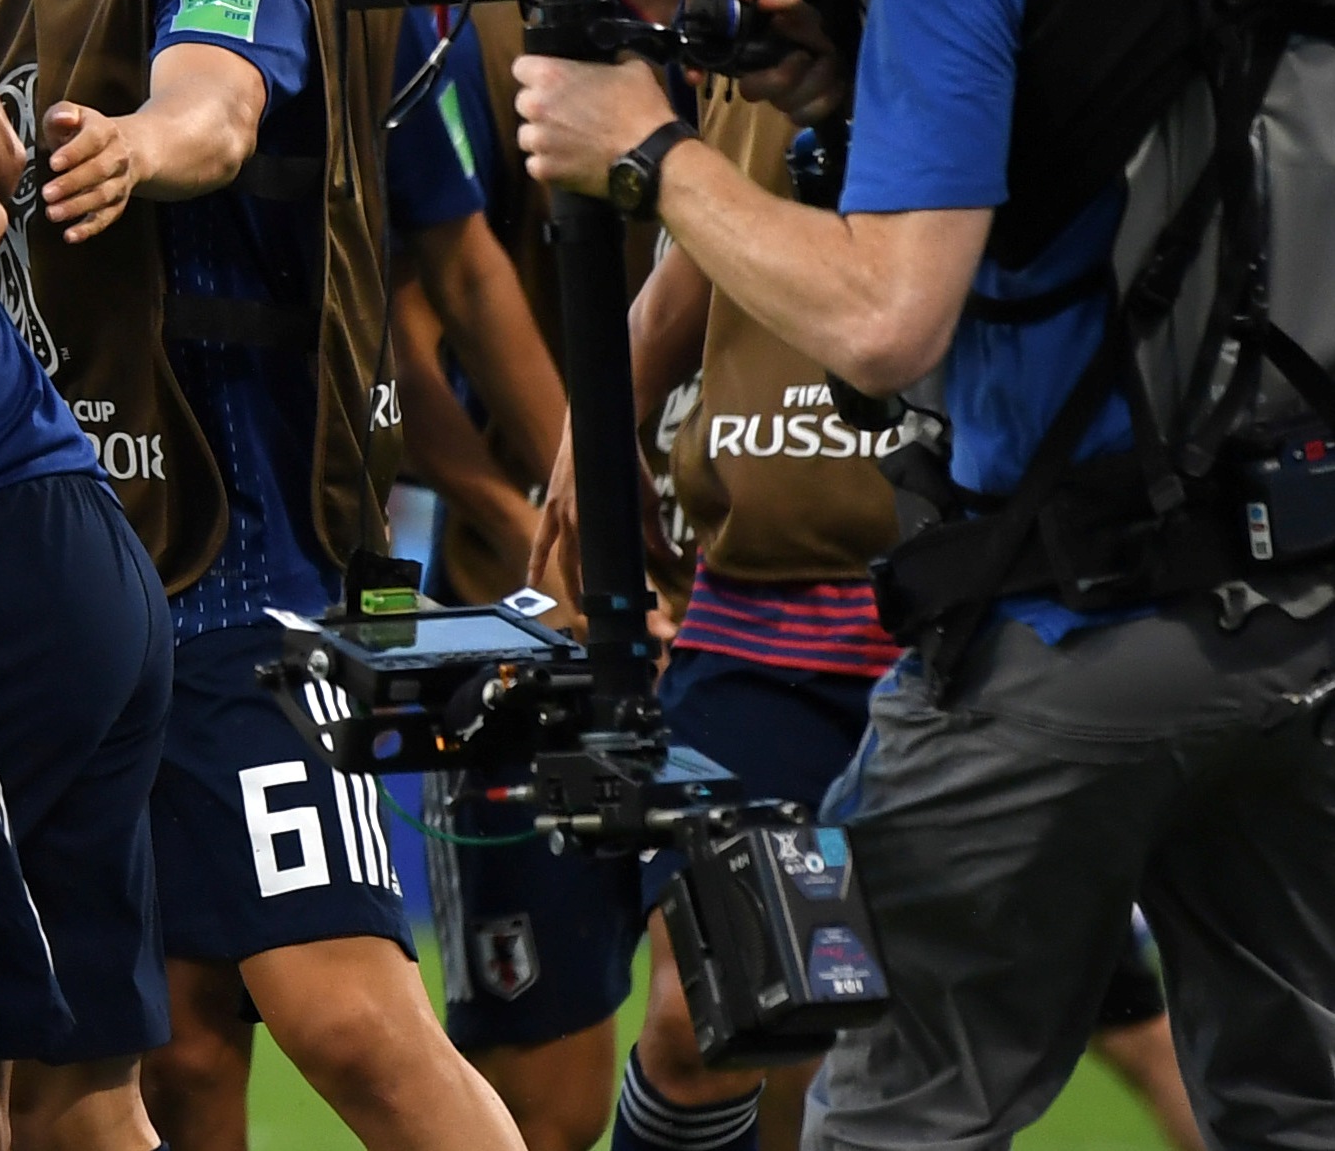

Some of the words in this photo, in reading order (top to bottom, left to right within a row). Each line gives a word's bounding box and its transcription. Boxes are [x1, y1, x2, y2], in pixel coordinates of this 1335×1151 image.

[224, 10, 251, 21] FIFA
[783, 383, 834, 407] FIFA
[73, 400, 116, 422] CUP
[238, 760, 330, 898] 6
